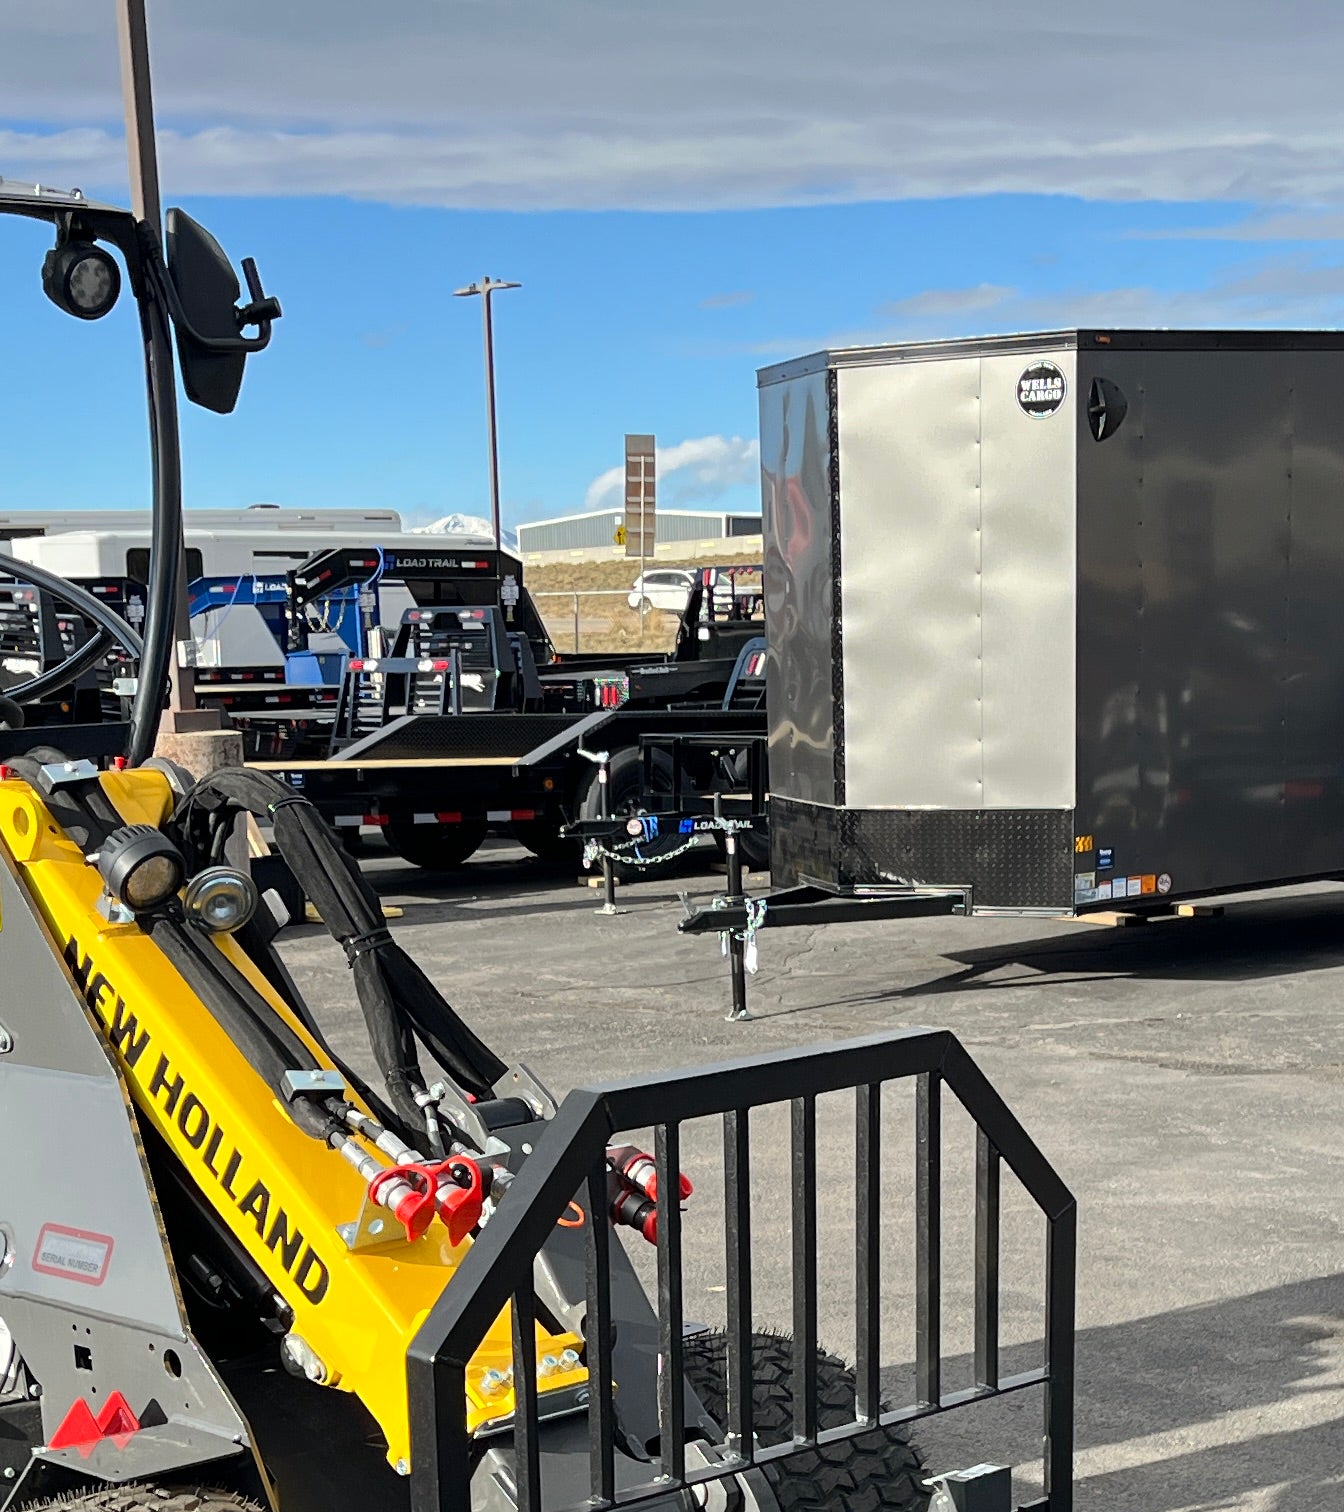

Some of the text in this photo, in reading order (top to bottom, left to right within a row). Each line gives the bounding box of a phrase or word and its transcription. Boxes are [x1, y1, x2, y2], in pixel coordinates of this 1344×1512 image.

[1020, 377, 1062, 390] WELLS
[1020, 389, 1062, 402] CARGO
[396, 558, 459, 568] LOAD TRAIL
[63, 934, 330, 1305] NEW HOLLAND
[40, 1251, 100, 1273] SERIAL NUMBER
